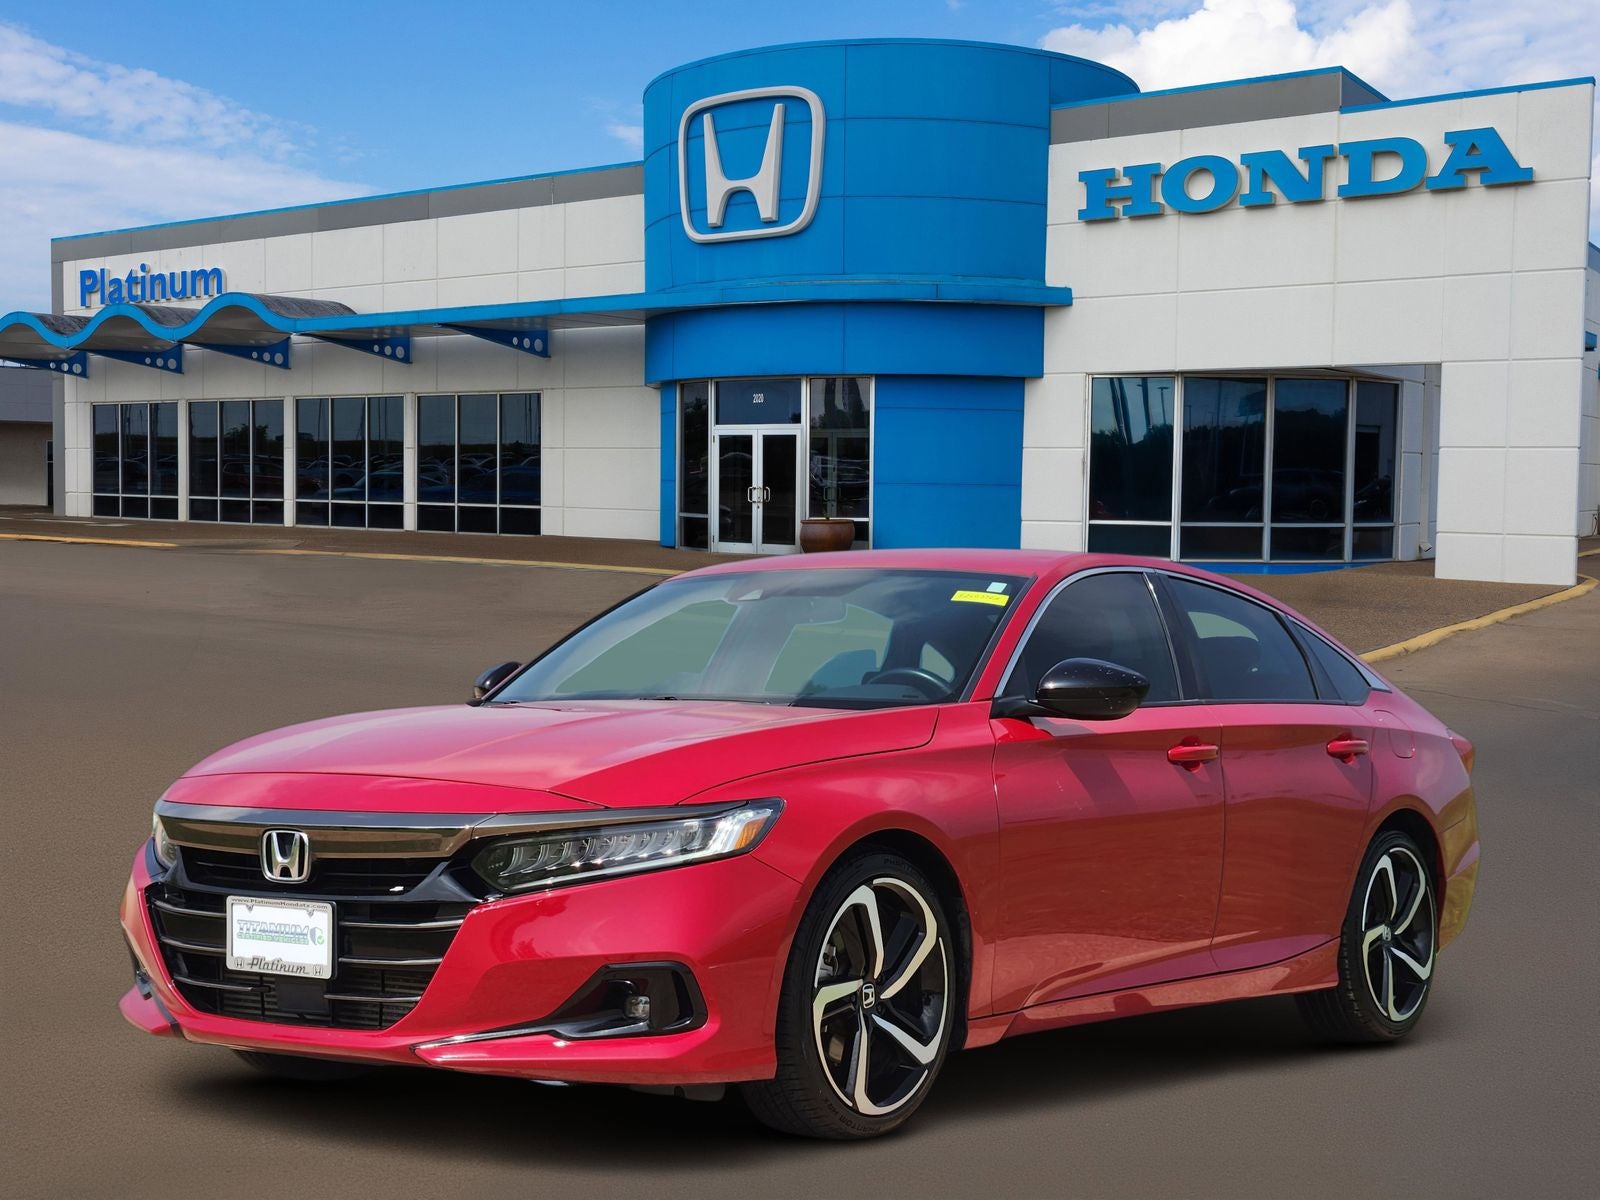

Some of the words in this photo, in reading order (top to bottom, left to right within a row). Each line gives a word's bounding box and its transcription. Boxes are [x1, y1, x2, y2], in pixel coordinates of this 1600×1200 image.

[1078, 126, 1534, 221] HONDA
[79, 263, 225, 307] Platinum
[236, 920, 309, 936] TITANIUM
[247, 955, 310, 975] Platinum
